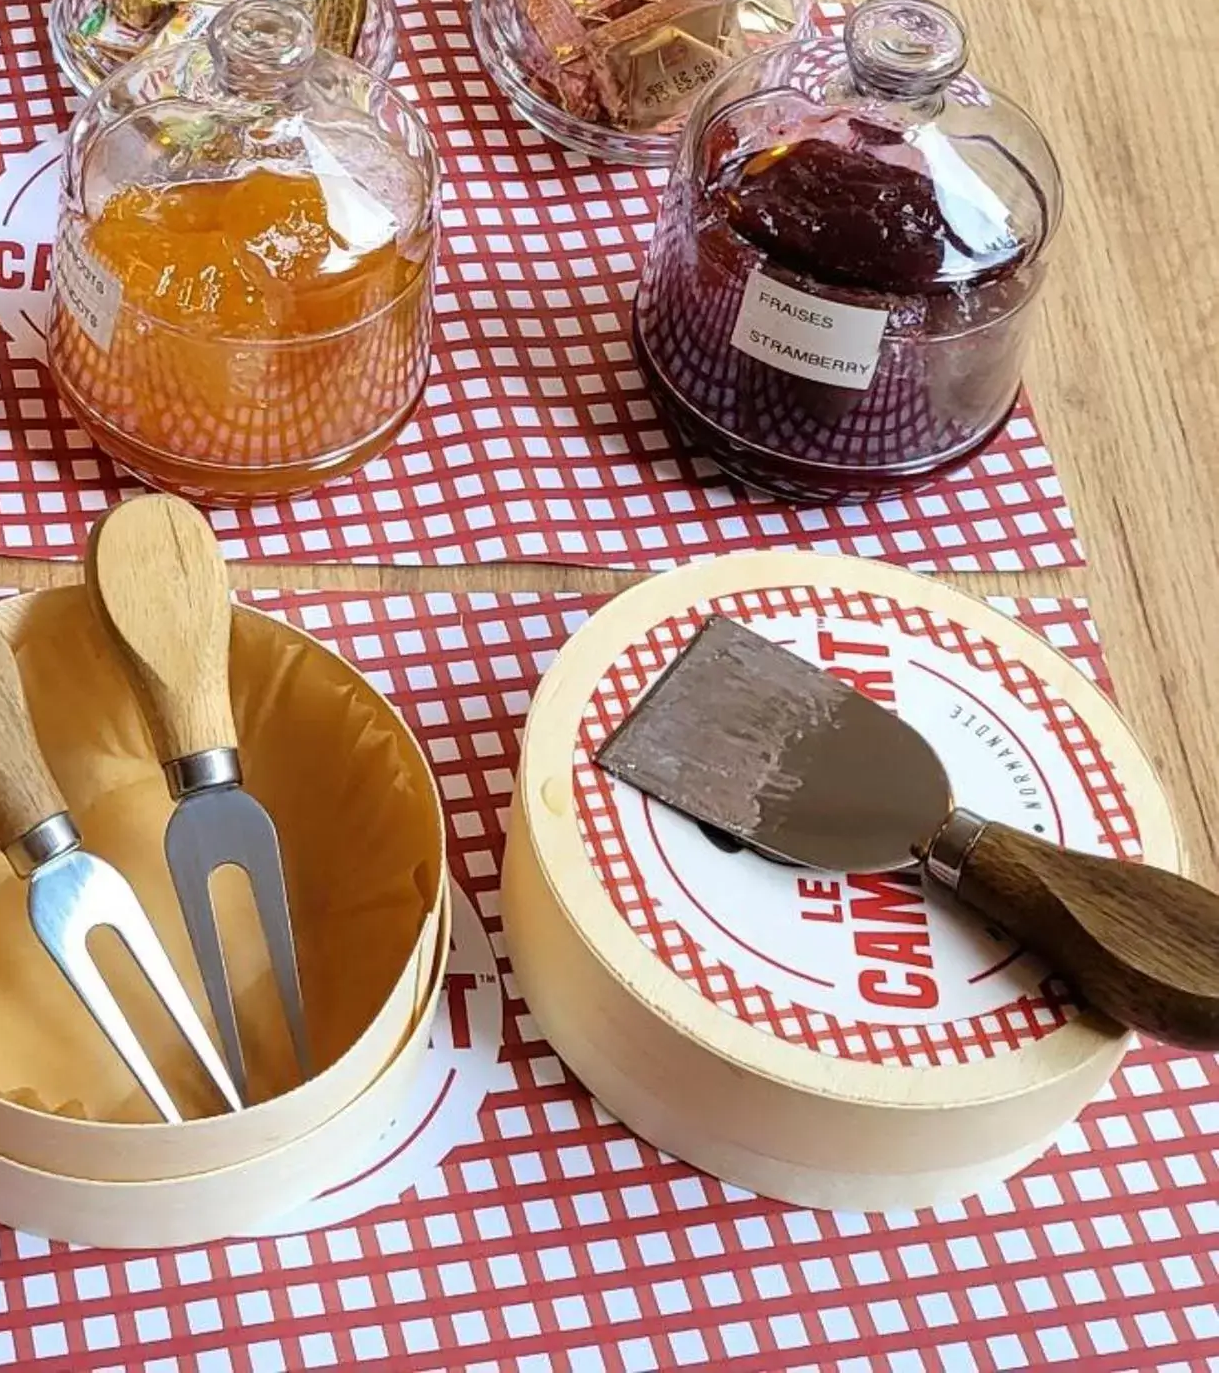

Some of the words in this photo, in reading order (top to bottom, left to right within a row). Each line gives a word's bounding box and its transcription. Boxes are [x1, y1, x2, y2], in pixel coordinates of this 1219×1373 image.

[759, 291, 834, 329] FRAISES
[749, 329, 871, 375] STRAMBERRY
[949, 703, 1043, 812] NORMANDIE
[797, 878, 844, 924] LE
